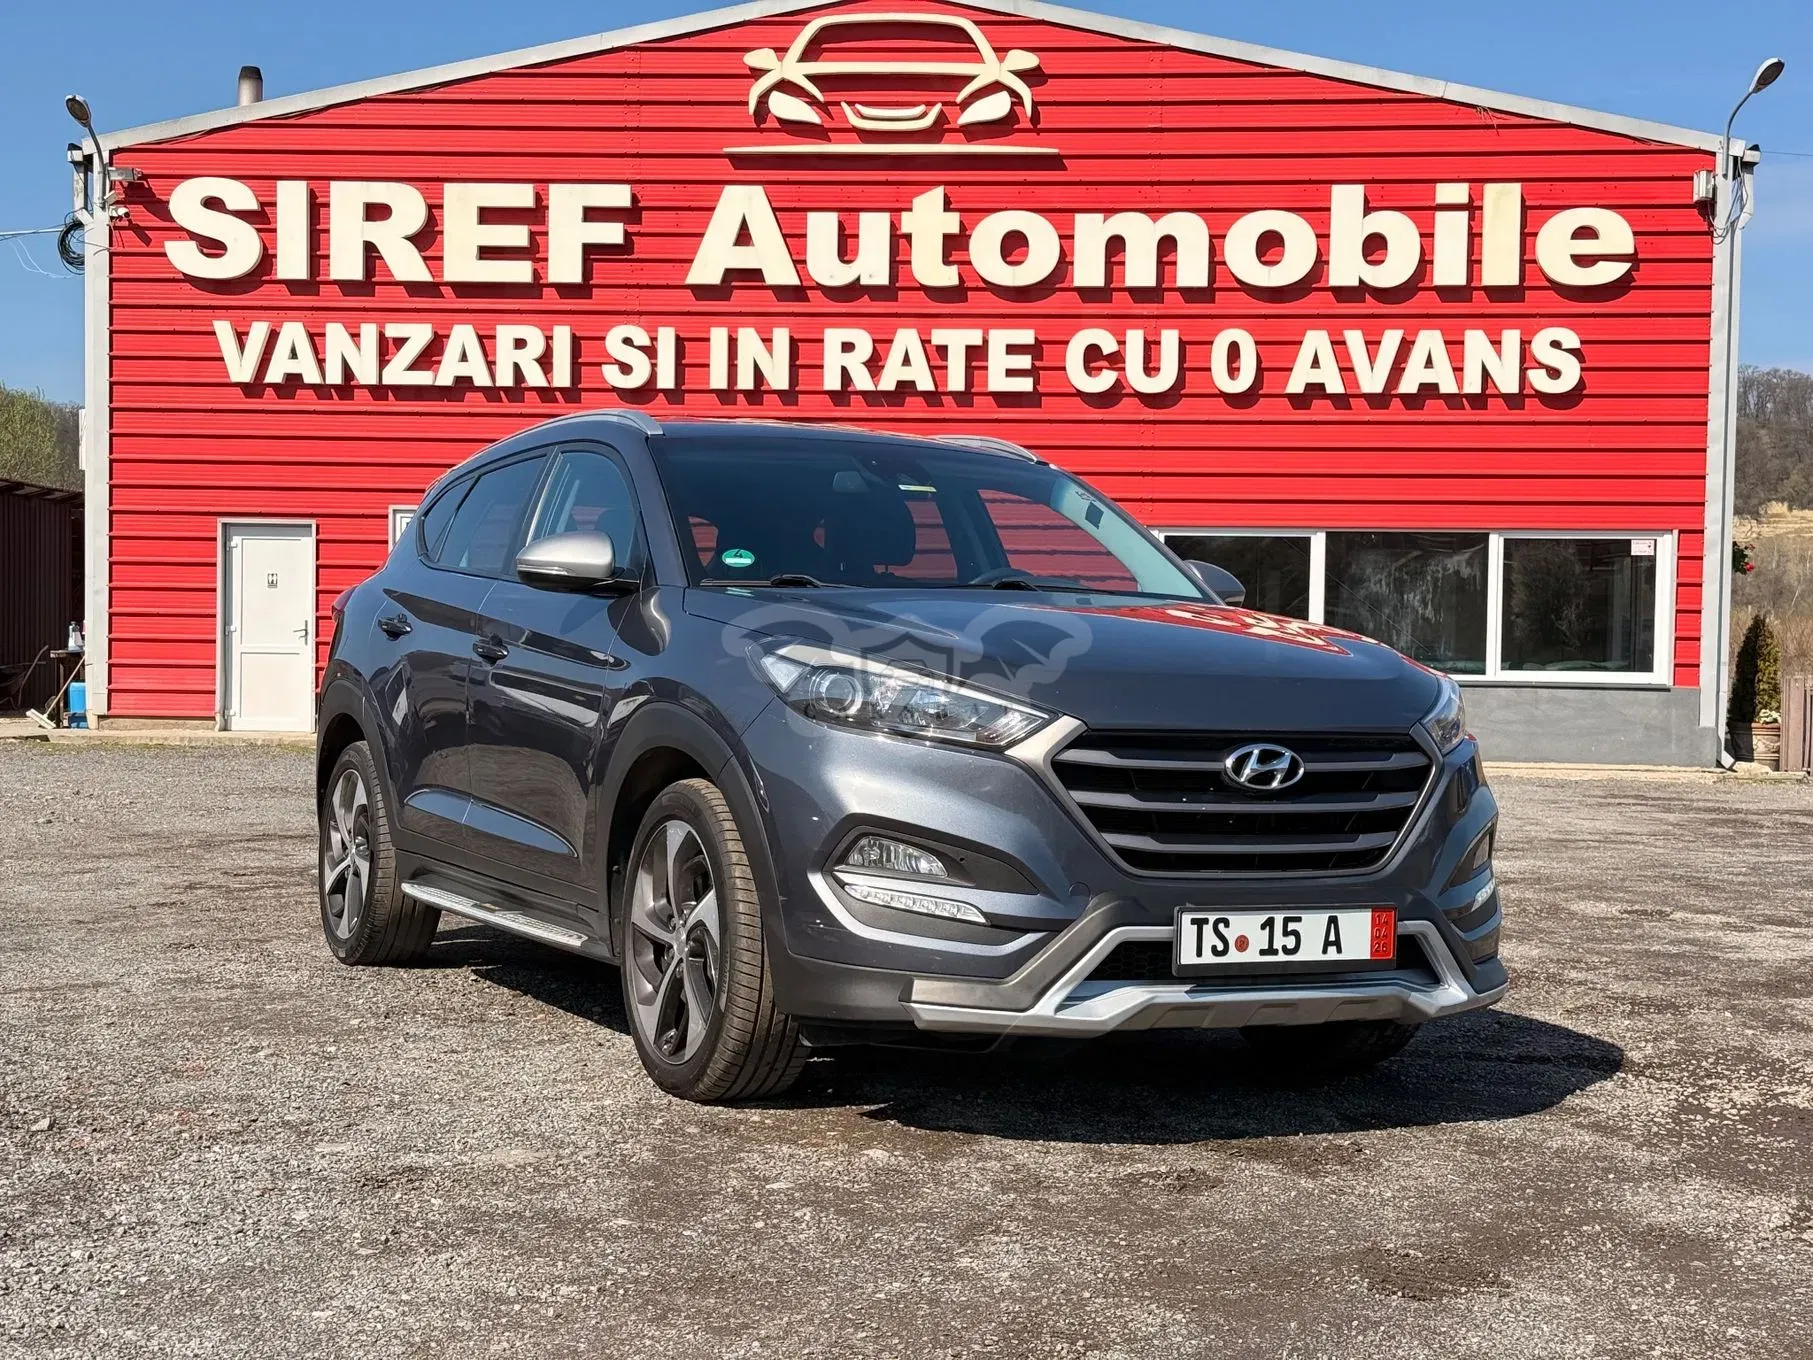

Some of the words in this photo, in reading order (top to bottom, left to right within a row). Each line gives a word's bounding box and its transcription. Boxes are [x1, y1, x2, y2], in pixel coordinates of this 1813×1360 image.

[164, 176, 635, 284] SIREF
[684, 180, 1637, 290] Automobile
[212, 319, 572, 389] VANZARI
[601, 324, 676, 390] SI
[709, 326, 790, 391] IN
[822, 327, 1036, 393] RATE
[1065, 327, 1180, 394] CU
[1210, 327, 1257, 394] 0
[1284, 326, 1582, 394] AVANS
[1190, 916, 1231, 958] TS
[1258, 915, 1304, 957] 15
[1321, 915, 1343, 955] A
